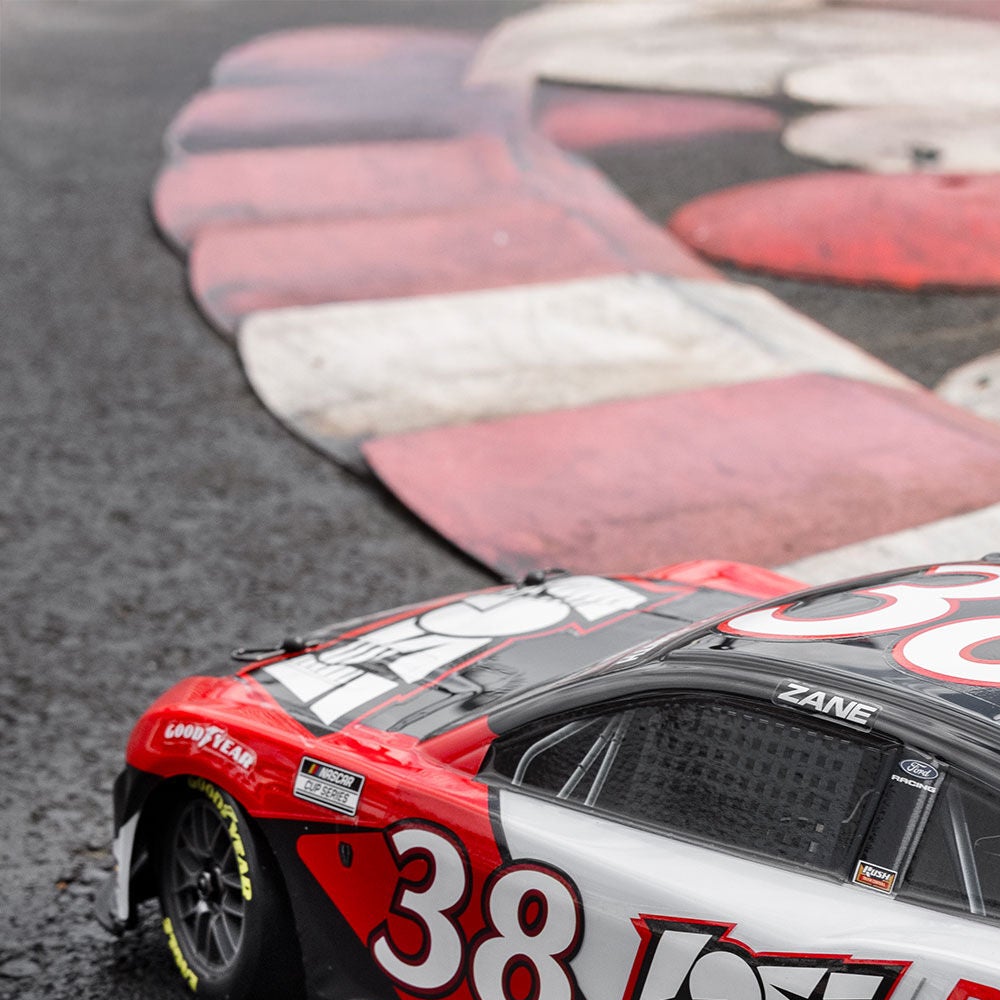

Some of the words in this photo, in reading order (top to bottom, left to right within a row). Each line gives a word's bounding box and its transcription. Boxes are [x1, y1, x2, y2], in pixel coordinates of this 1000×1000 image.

[777, 683, 878, 725] ZANE
[164, 722, 255, 770] GOODYEAR
[318, 765, 355, 788] NASCAR
[906, 761, 931, 777] Ford
[303, 779, 321, 796] CUP
[320, 784, 350, 804] SERIES
[891, 774, 937, 793] RACING
